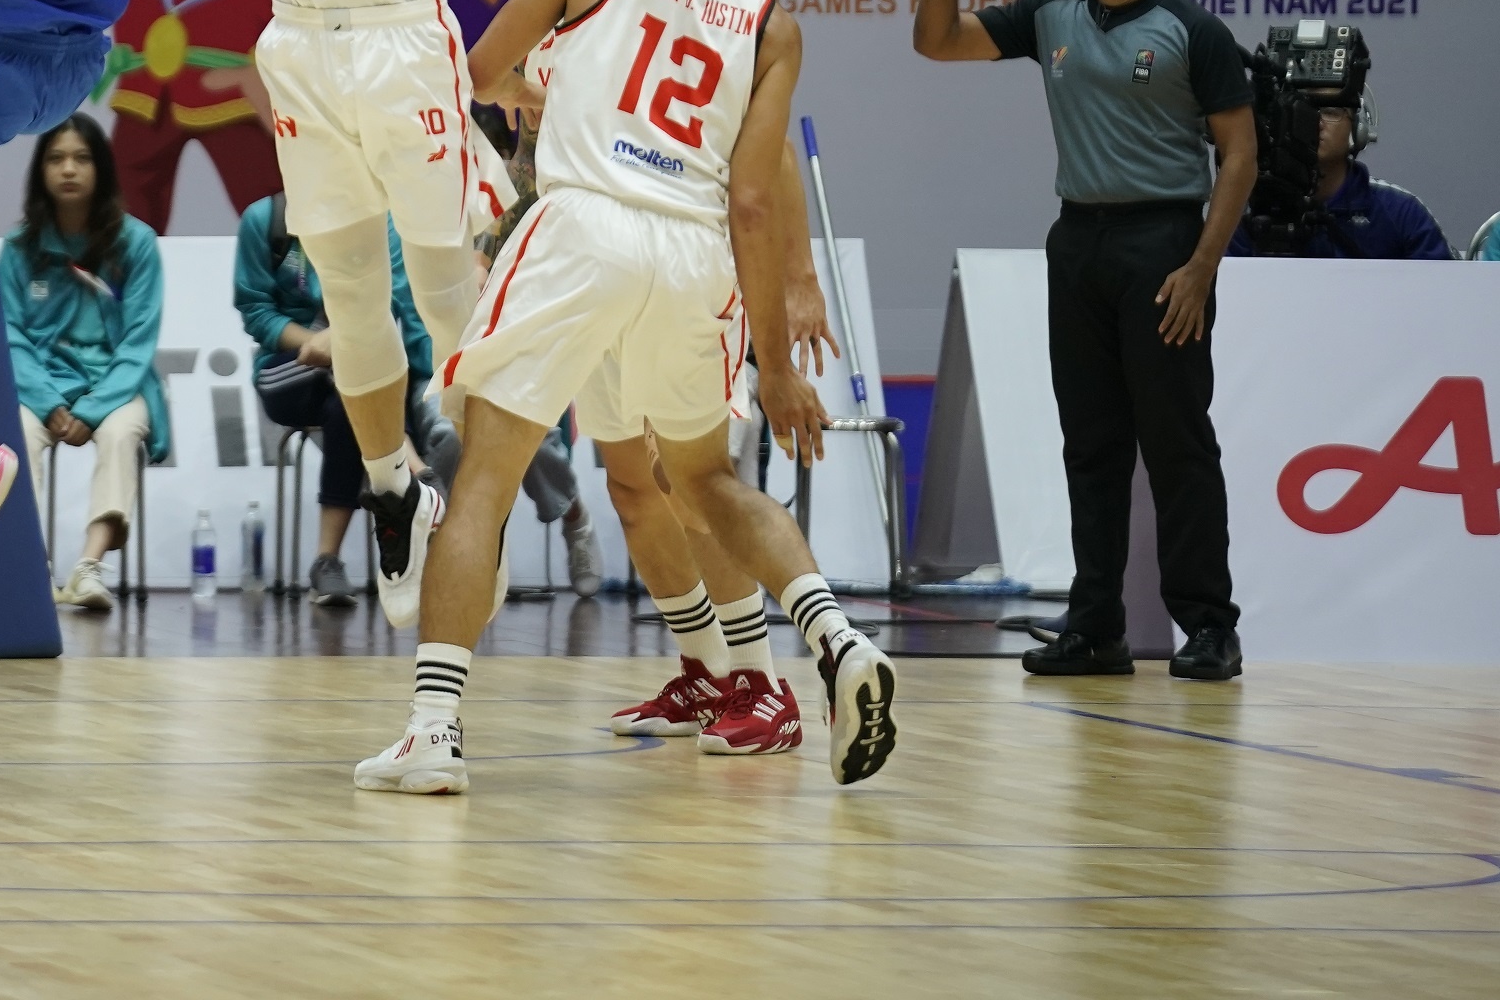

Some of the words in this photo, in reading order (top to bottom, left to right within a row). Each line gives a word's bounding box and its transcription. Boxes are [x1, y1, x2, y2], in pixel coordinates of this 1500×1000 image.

[617, 12, 724, 149] 12
[419, 108, 446, 135] 10
[613, 139, 684, 173] molten
